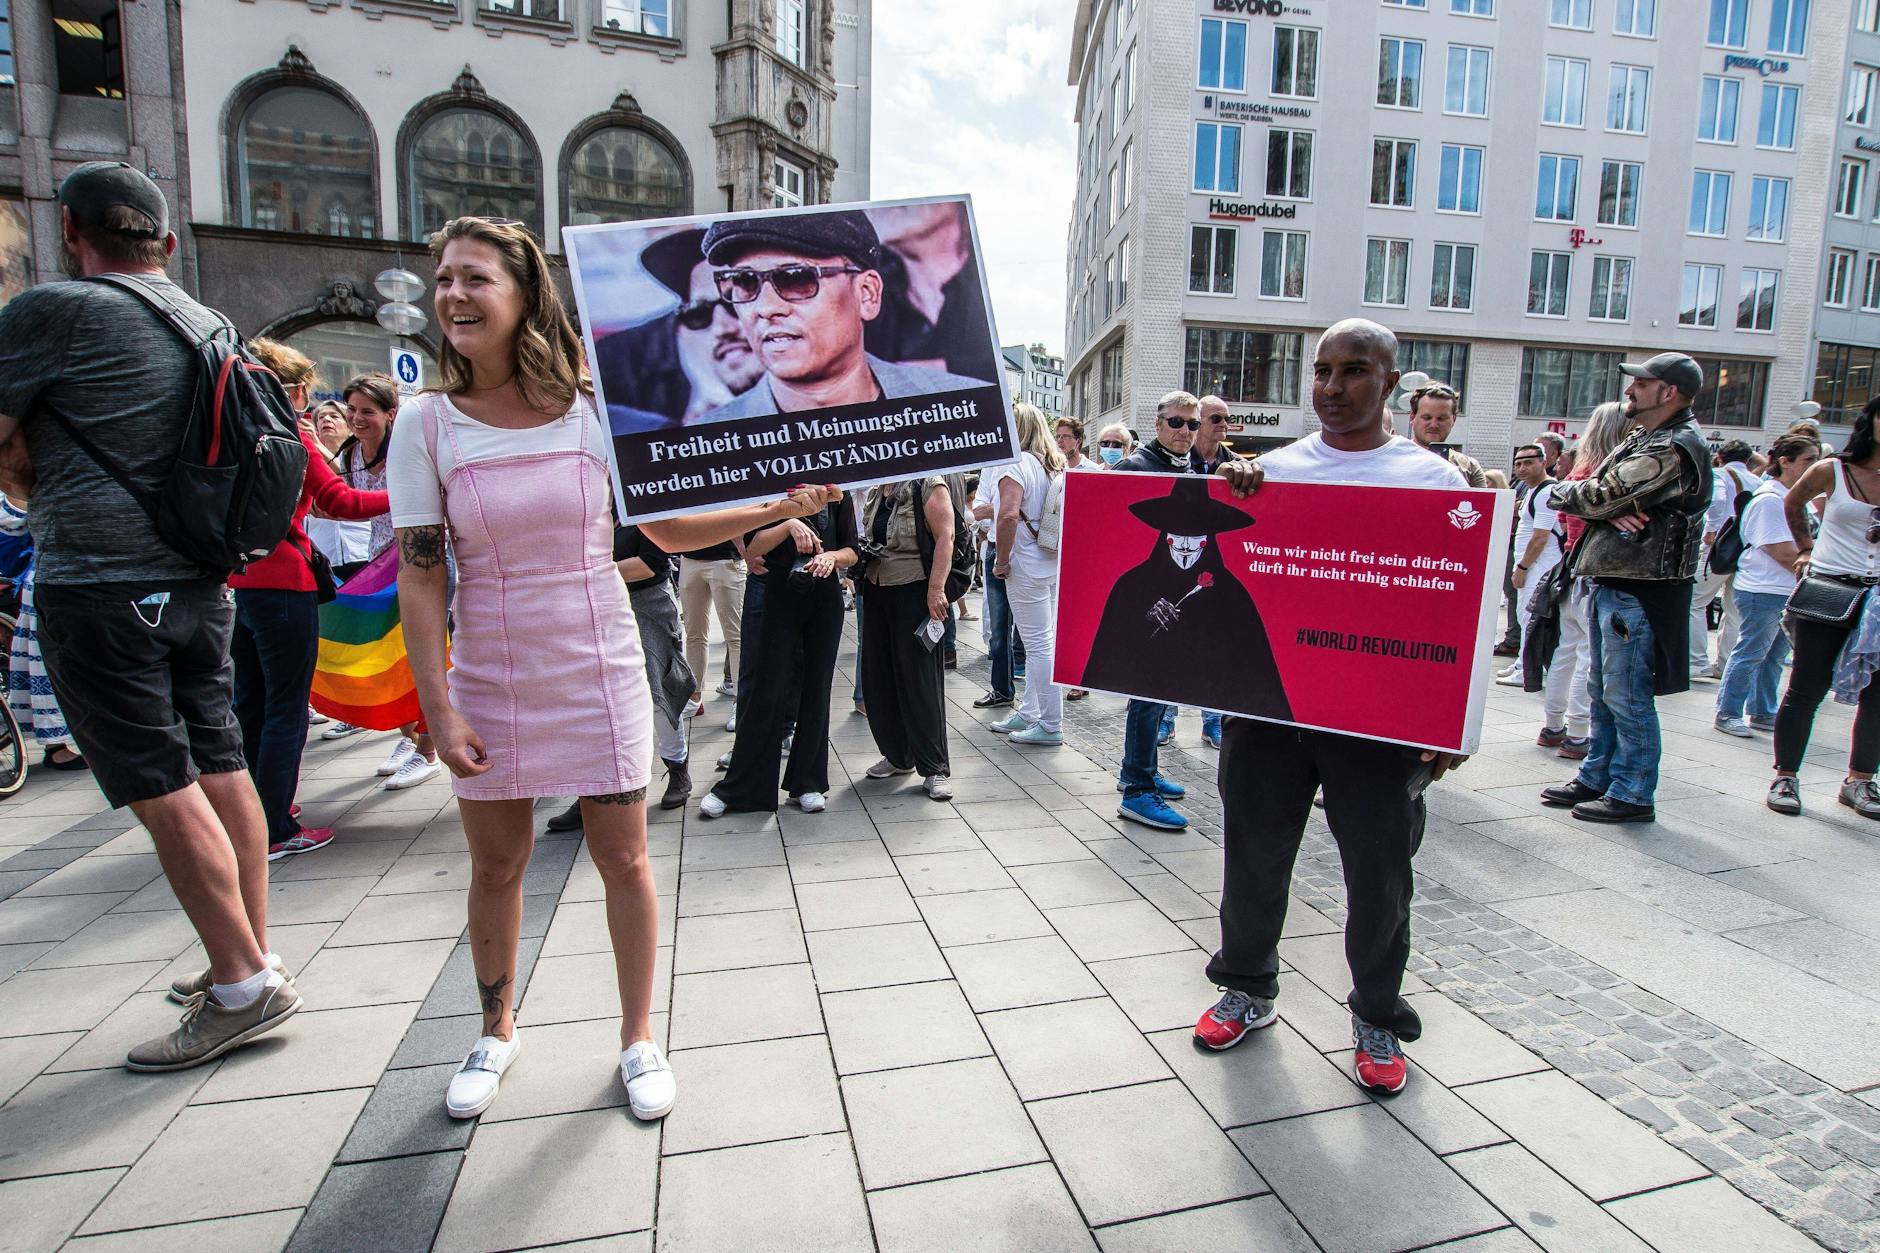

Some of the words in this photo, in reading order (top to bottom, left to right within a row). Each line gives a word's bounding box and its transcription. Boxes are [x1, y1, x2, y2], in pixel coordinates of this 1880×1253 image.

[1220, 100, 1269, 114] BAYERISCHE
[1271, 105, 1311, 118] HAUSBAU
[1209, 198, 1296, 219] Hugendubel
[648, 432, 742, 462] Freiheit
[746, 424, 791, 448] und
[795, 399, 978, 442] Meinungsfreiheit
[1227, 412, 1280, 426] endubel
[627, 473, 706, 498] werden
[708, 466, 751, 486] hier
[753, 438, 919, 478] VOLLSTÄNDIG
[923, 426, 1004, 454] erhalten!
[1242, 541, 1280, 557] Wenn
[1284, 546, 1307, 559] wir
[1310, 548, 1346, 562] nicht
[1349, 550, 1375, 564] frei
[1378, 554, 1407, 567] sein
[1411, 556, 1468, 575] dürfen,
[1249, 560, 1284, 575] dürft
[1287, 563, 1307, 577] ihr
[1310, 566, 1346, 580] nicht
[1349, 570, 1390, 588] ruhig
[1392, 575, 1455, 591] schlafen
[1296, 628, 1358, 651] #WORLD
[1361, 636, 1458, 665] REVOLUTION
